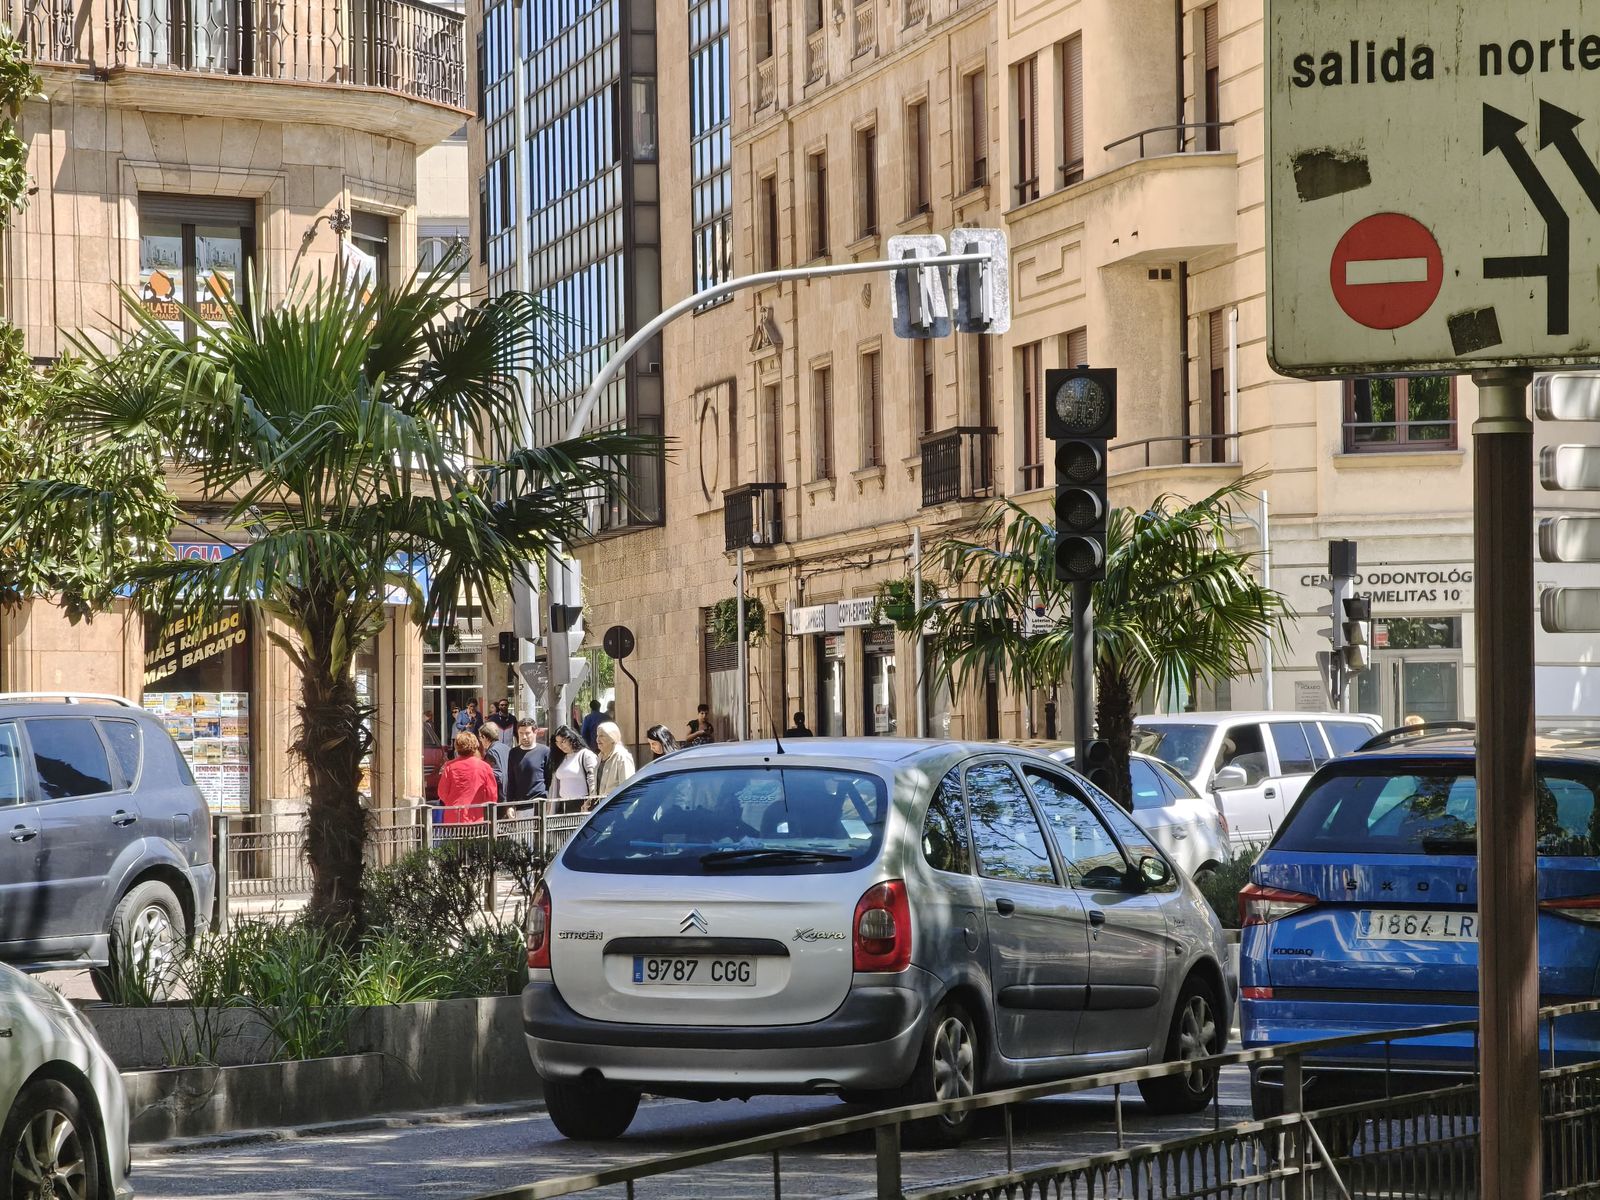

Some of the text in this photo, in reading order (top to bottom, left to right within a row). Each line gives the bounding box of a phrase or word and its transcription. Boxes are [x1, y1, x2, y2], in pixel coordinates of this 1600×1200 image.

[1292, 28, 1600, 88] salida norte
[1300, 568, 1473, 587] CENO ODONTOLÓG
[1353, 589, 1460, 602] ARMELITAS 10
[143, 628, 246, 687] MAS BARATO
[1376, 914, 1478, 938] 1864 LR
[1273, 948, 1314, 957] KODIAQ
[647, 959, 699, 981] 9787
[711, 960, 750, 983] CGG
